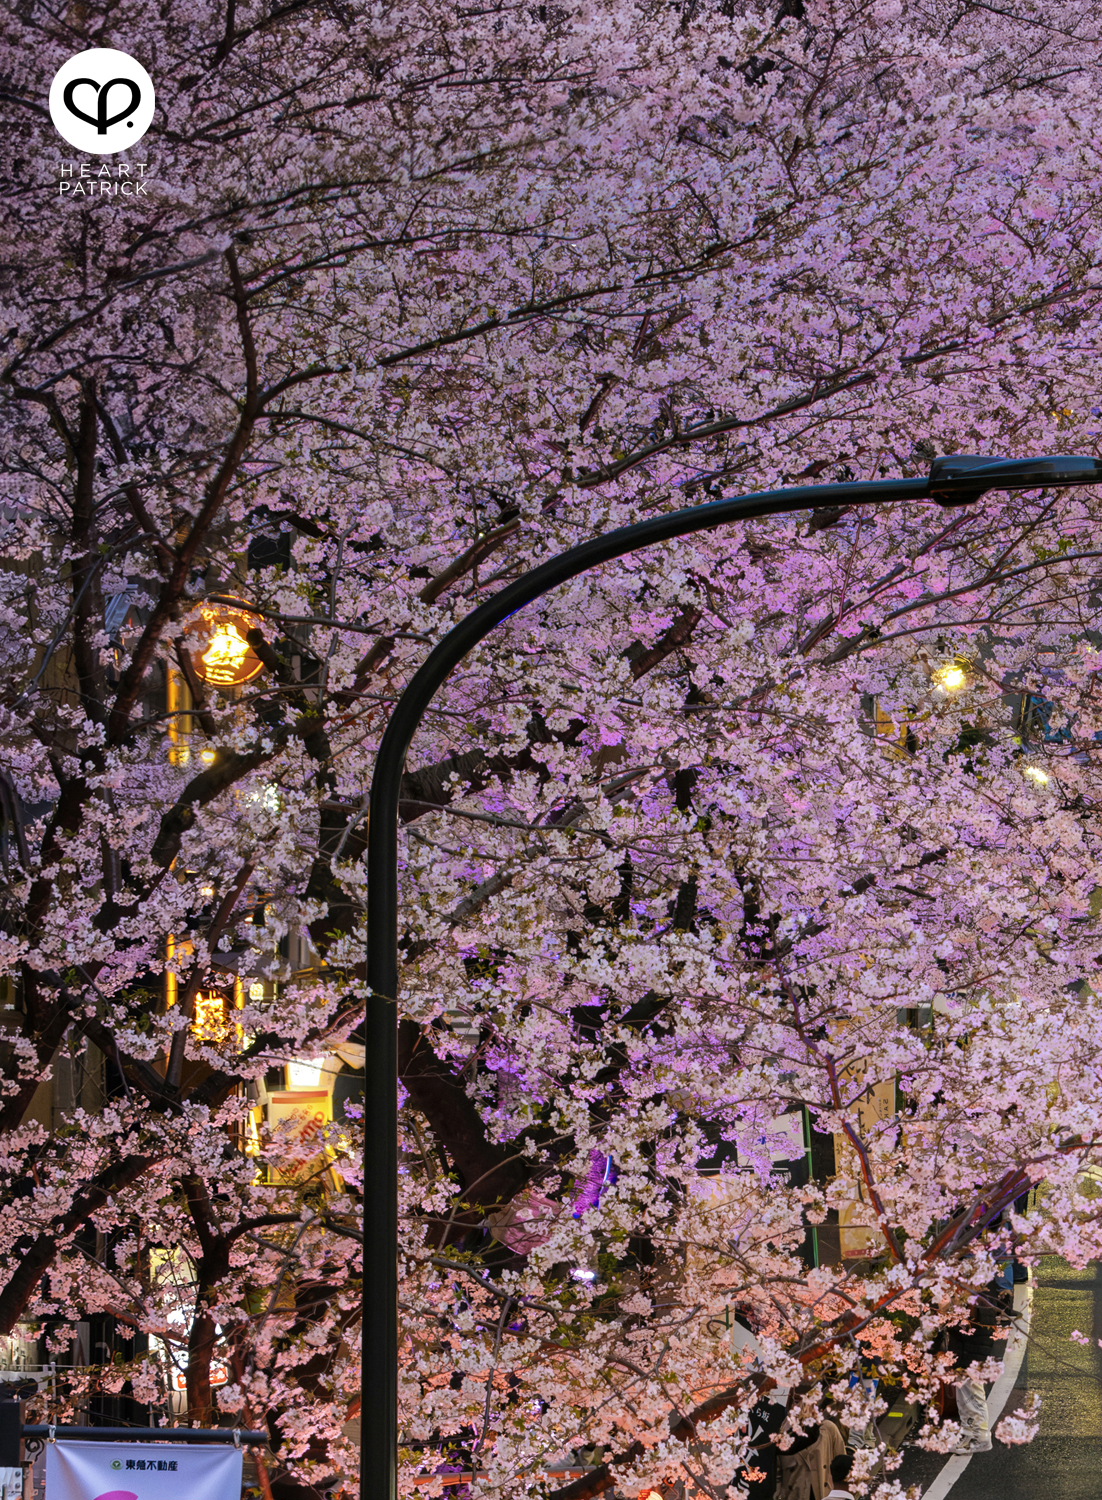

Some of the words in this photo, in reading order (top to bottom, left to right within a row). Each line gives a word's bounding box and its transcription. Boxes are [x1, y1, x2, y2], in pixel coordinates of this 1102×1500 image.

[125, 1459, 178, 1471] 東急不動産
